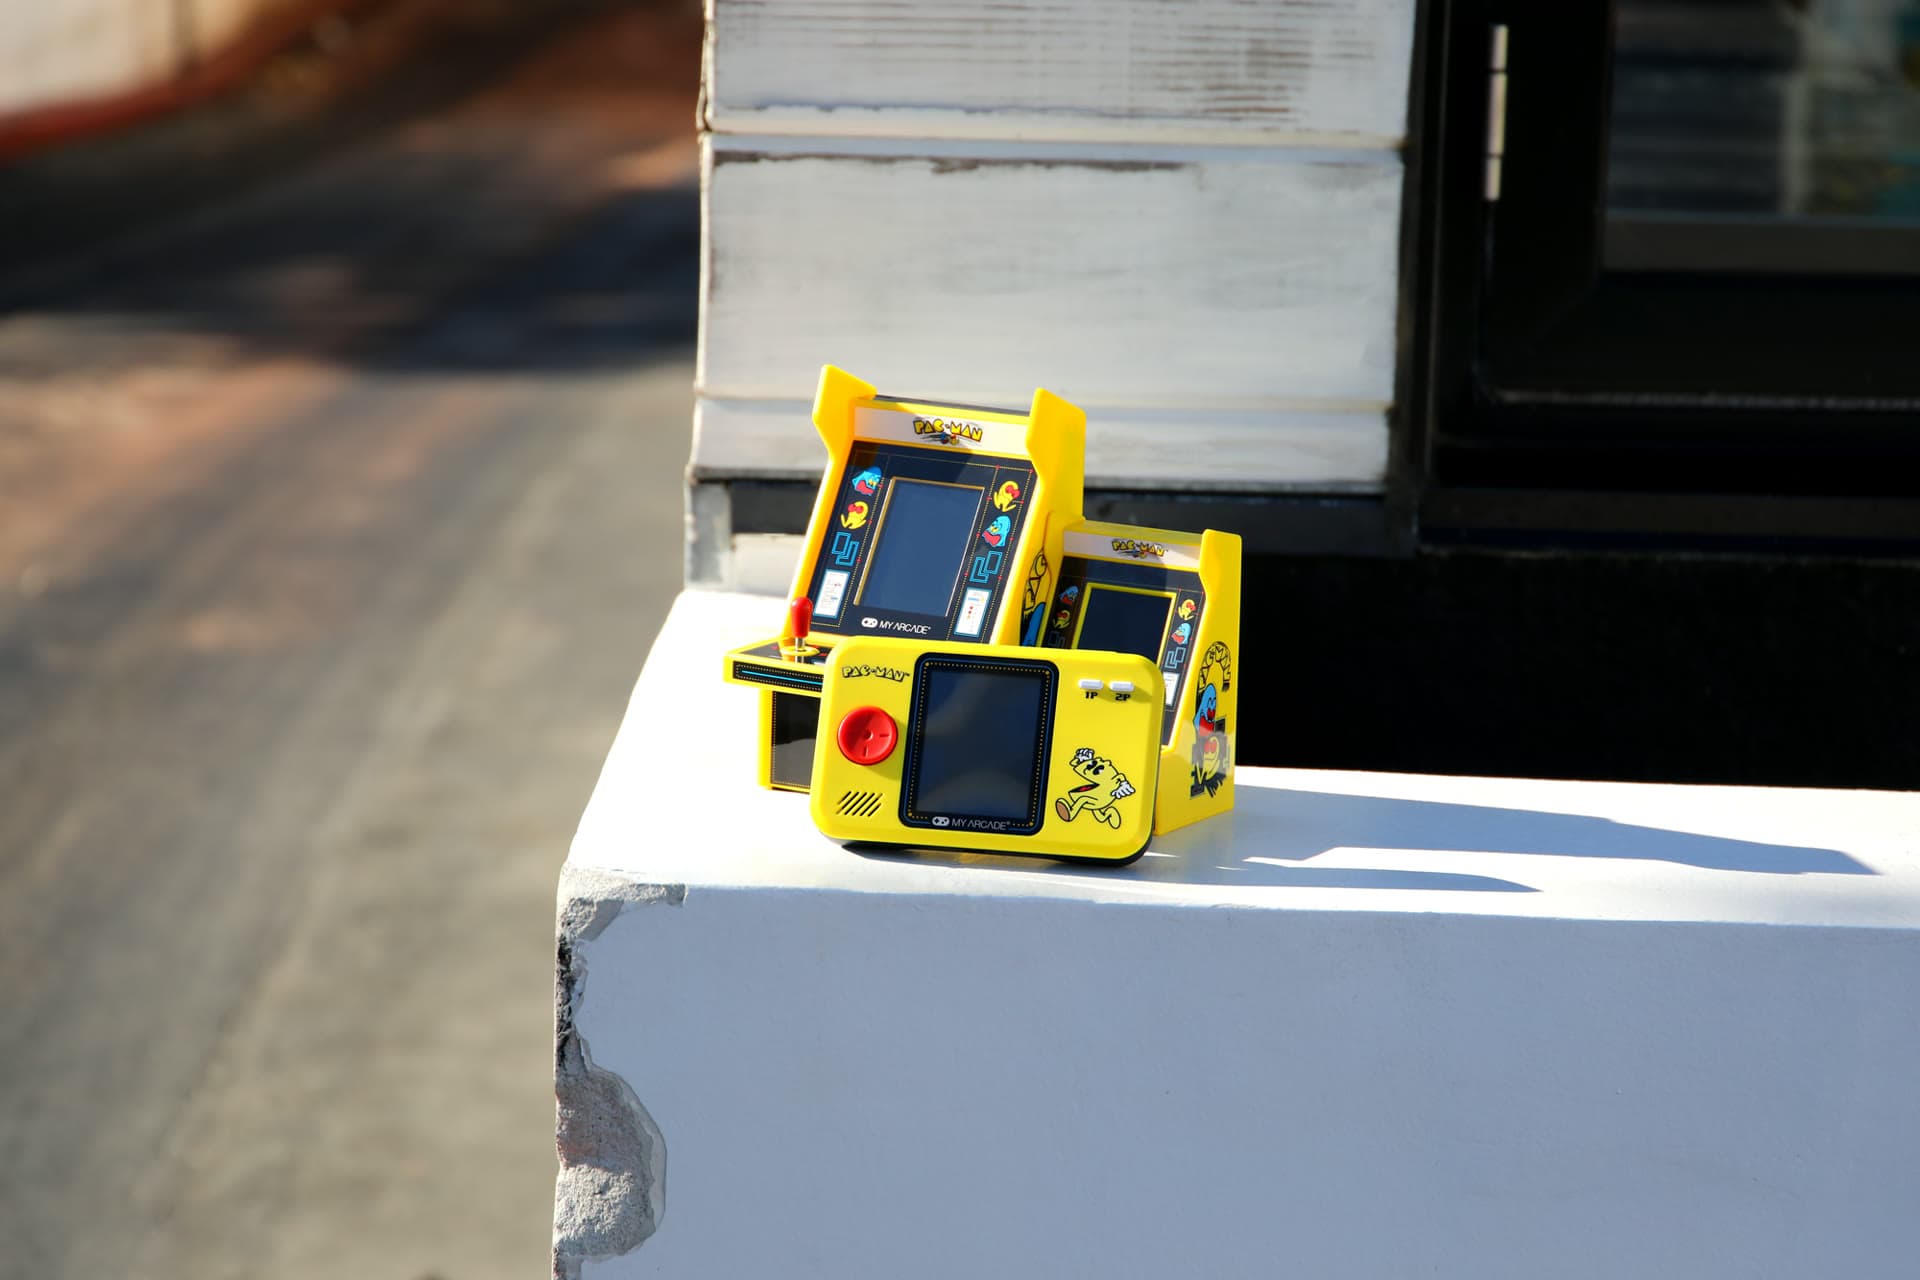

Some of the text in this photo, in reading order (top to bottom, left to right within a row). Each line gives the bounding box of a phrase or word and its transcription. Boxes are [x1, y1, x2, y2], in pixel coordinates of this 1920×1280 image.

[913, 418, 983, 442] PAC-MAN
[879, 620, 893, 629] MY
[1085, 691, 1098, 699] 1P
[1115, 692, 1131, 701] 2P
[951, 818, 967, 827] MY
